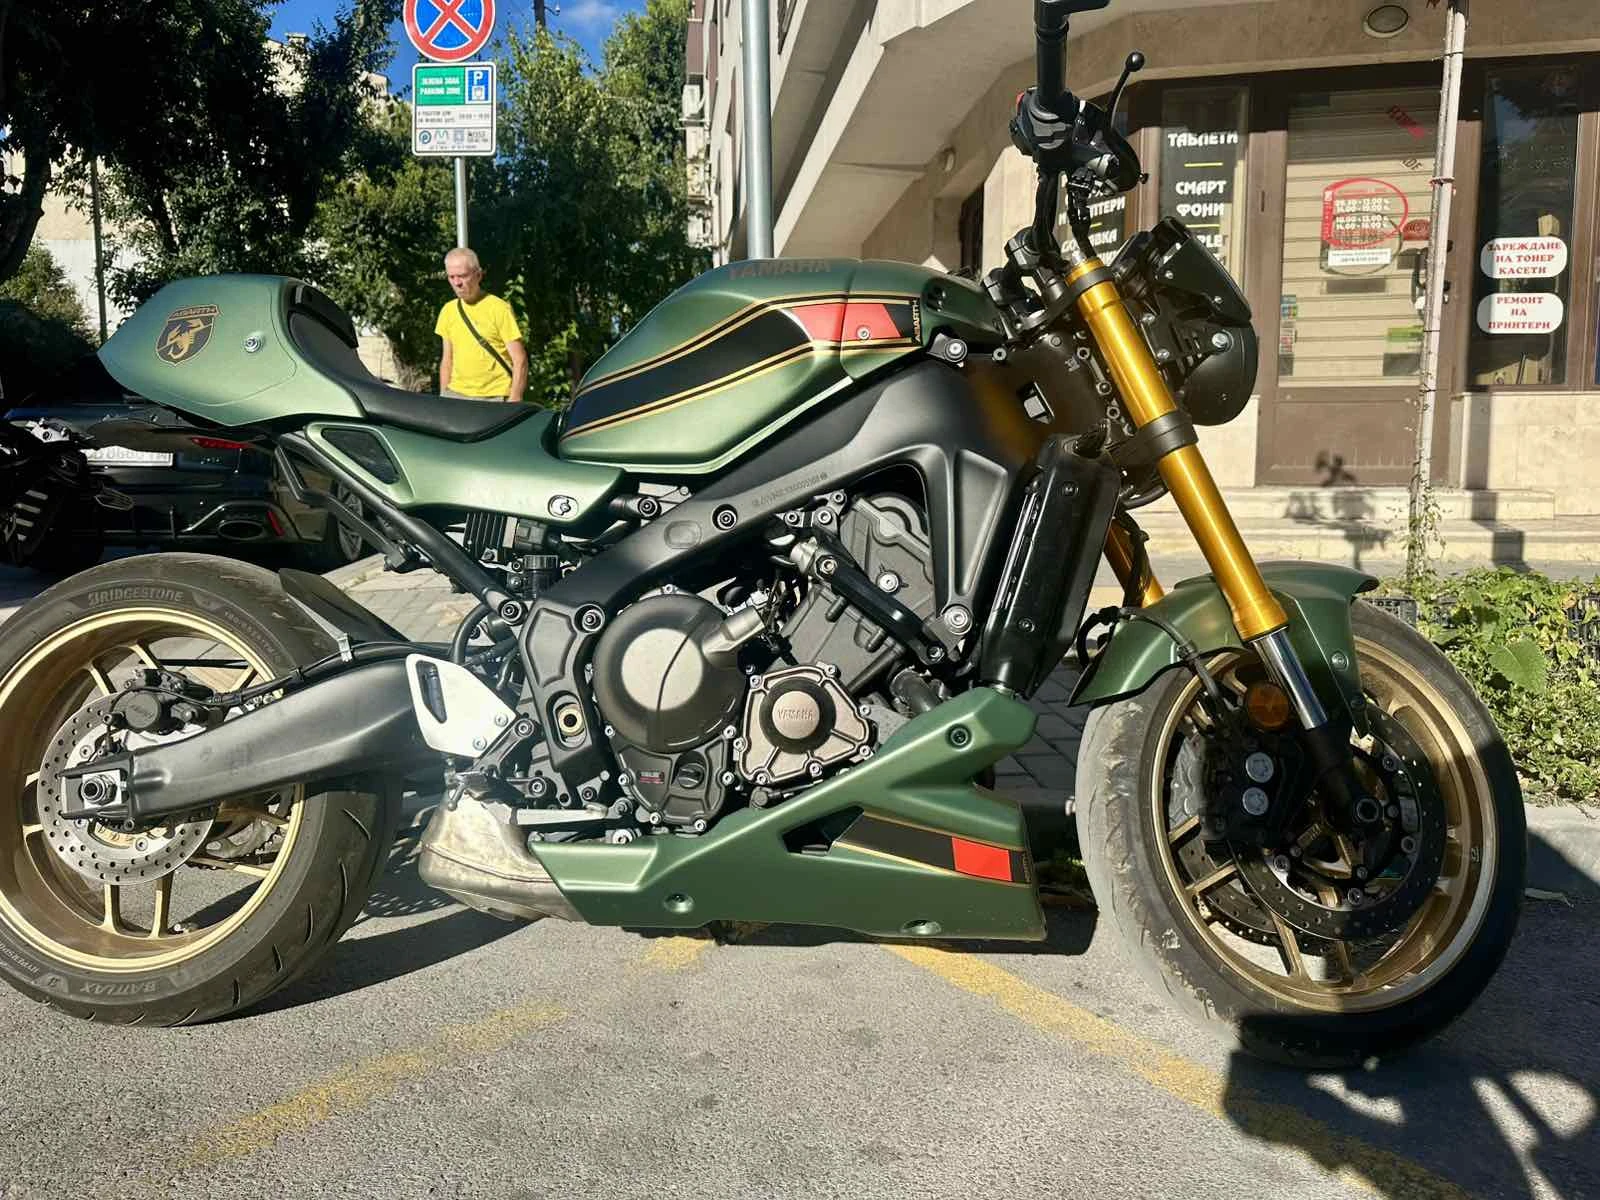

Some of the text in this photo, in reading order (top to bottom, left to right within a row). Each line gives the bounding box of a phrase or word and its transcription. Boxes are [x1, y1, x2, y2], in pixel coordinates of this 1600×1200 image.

[473, 71, 483, 85] P
[1168, 131, 1238, 147] ТАБЛЕТИ
[1176, 180, 1227, 195] СМАРТ
[1176, 203, 1225, 217] ФОНИ
[1196, 234, 1223, 248] PLE
[1486, 242, 1561, 252] ЗАРЕЖДАНЕ
[1496, 254, 1554, 263] НА ТОНЕР
[1499, 267, 1547, 275] КАСЕТИ
[1497, 296, 1544, 304] РЕМОНТ
[1511, 308, 1527, 316] НА
[1488, 321, 1551, 329] ПРИНТЕРИ
[87, 586, 184, 606] BRIDGESTONE
[777, 708, 816, 722] YAMAHA
